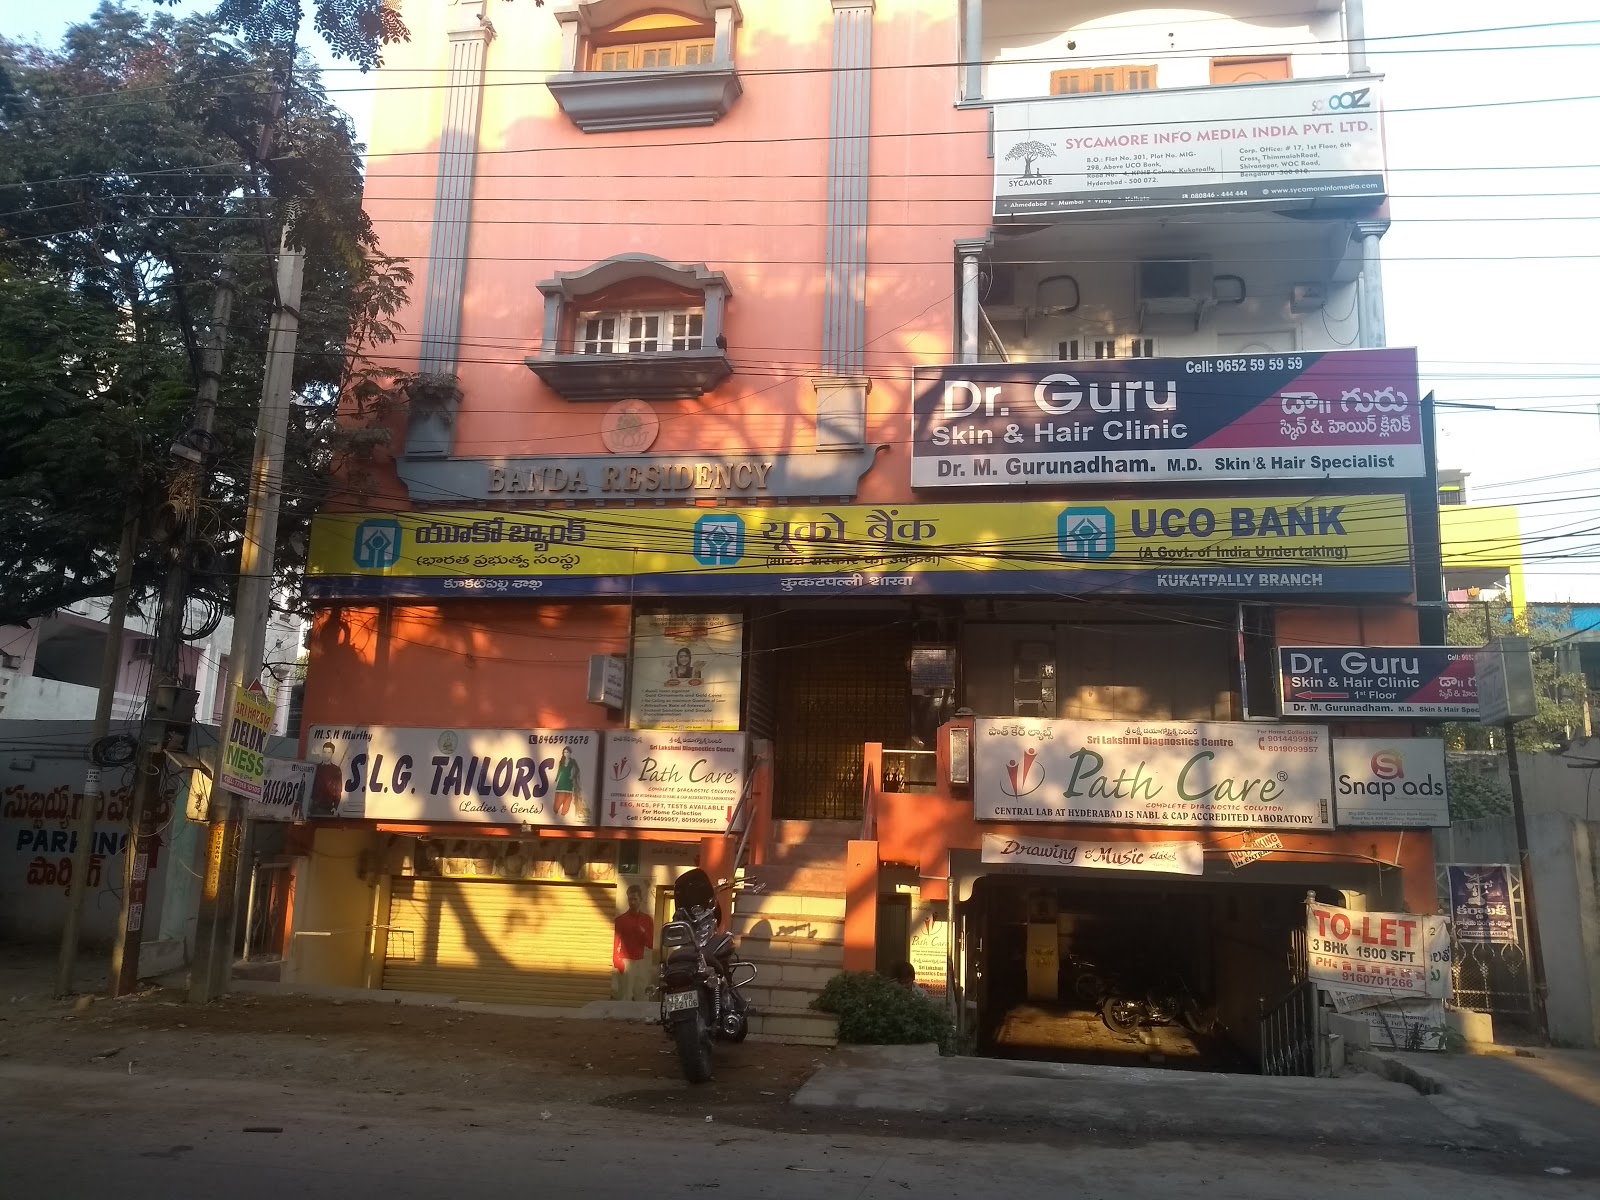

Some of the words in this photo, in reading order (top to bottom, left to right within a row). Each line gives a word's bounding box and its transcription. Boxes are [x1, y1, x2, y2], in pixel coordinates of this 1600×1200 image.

[1065, 133, 1149, 150] SYCAMORE
[1153, 131, 1192, 145] INFO
[1196, 128, 1248, 142] MEDIA
[1252, 125, 1299, 138] INDIA
[1303, 122, 1334, 135] PVT.
[1340, 120, 1373, 133] LTD.
[1151, 152, 1165, 160] Plot
[1239, 147, 1258, 156] Corp.
[1259, 145, 1283, 153] Office:
[1318, 142, 1338, 150] Floor,
[1008, 178, 1053, 187] SYCAMORE
[1086, 178, 1123, 188] Hyderabad
[1271, 182, 1378, 195] www.sycamoreinfomedia.com
[1235, 189, 1248, 197] 444
[1185, 360, 1213, 374] Cell:
[1216, 359, 1247, 373] 9652
[1250, 358, 1265, 371] 59
[1269, 357, 1284, 370] 59
[1288, 356, 1303, 370] 59
[944, 380, 1009, 418] Dr.
[1034, 373, 1177, 415] Guru
[932, 425, 993, 446] Skin
[1003, 423, 1025, 444] &
[1034, 421, 1094, 443] Hair
[1103, 418, 1188, 442] Clinic
[1310, 419, 1324, 434] &
[937, 459, 966, 477] Dr.
[973, 458, 998, 476] M.
[1005, 456, 1156, 475] Gurunadham.
[1167, 458, 1203, 472] M.D.
[1214, 457, 1250, 471] Skin
[1255, 457, 1267, 470] &
[1271, 456, 1306, 470] Hair
[1316, 453, 1395, 472] Specialist
[487, 465, 588, 493] BANDA
[601, 461, 773, 492] RESIDENCY
[1131, 507, 1216, 538] UCO
[1230, 505, 1349, 537] BANK
[759, 511, 849, 555] यूको
[864, 508, 940, 542] बैंक
[1157, 545, 1193, 559] Govt.
[1196, 545, 1211, 558] of
[1216, 545, 1251, 559] India
[1255, 544, 1349, 560] Undertaking)
[1157, 573, 1253, 588] KUKATPALLY
[1258, 572, 1323, 587] BRANCH
[1290, 652, 1328, 675] Dr.
[1340, 651, 1420, 675] Guru
[1291, 676, 1324, 688] Skin
[1328, 676, 1339, 688] &
[1343, 676, 1374, 688] Hair
[1377, 675, 1420, 688] Clinic
[1369, 690, 1397, 700] Floor
[1293, 703, 1307, 712] Dr.
[1310, 703, 1323, 712] M.
[1325, 703, 1394, 713] Gurunadham.
[1398, 705, 1415, 713] M.D.
[341, 730, 373, 743] Murthy
[538, 734, 590, 746] 8465913678
[1087, 735, 1101, 745] Sri
[1102, 735, 1142, 746] Lakshmi
[1143, 736, 1200, 748] Diagnostics
[1201, 738, 1234, 747] Centre
[225, 744, 264, 777] MESS
[344, 752, 416, 796] S.L.G.
[430, 754, 555, 801] TAILORS
[638, 756, 684, 783] Path
[1062, 746, 1164, 800] Path
[1338, 773, 1397, 802] Snap
[1402, 773, 1445, 796] ads
[458, 800, 498, 815] (Ladies
[500, 803, 508, 814] &
[510, 801, 544, 816] Gents)
[689, 803, 725, 811] AVAILABLE
[994, 806, 1034, 817] CENTRAL
[1036, 807, 1053, 817] LAB
[1055, 808, 1066, 817] AT
[1068, 808, 1123, 819] HYDERABAD
[1125, 810, 1134, 819] IS
[1136, 811, 1160, 820] NABL
[1162, 811, 1169, 820] &
[1171, 811, 1189, 821] CAP
[1191, 812, 1250, 822] ACCREDITED
[1252, 813, 1314, 824] LABORATORY
[1190, 803, 1241, 812] DIAGNOSTIC
[1000, 839, 1078, 864] Drawing
[1093, 846, 1144, 867] Music
[1313, 909, 1417, 948] TO-LET
[1312, 938, 1320, 951] 3
[1323, 940, 1350, 956] BHK
[1356, 945, 1387, 961] 1500
[1390, 950, 1416, 963] SFT
[1342, 971, 1415, 988] 9160701266
